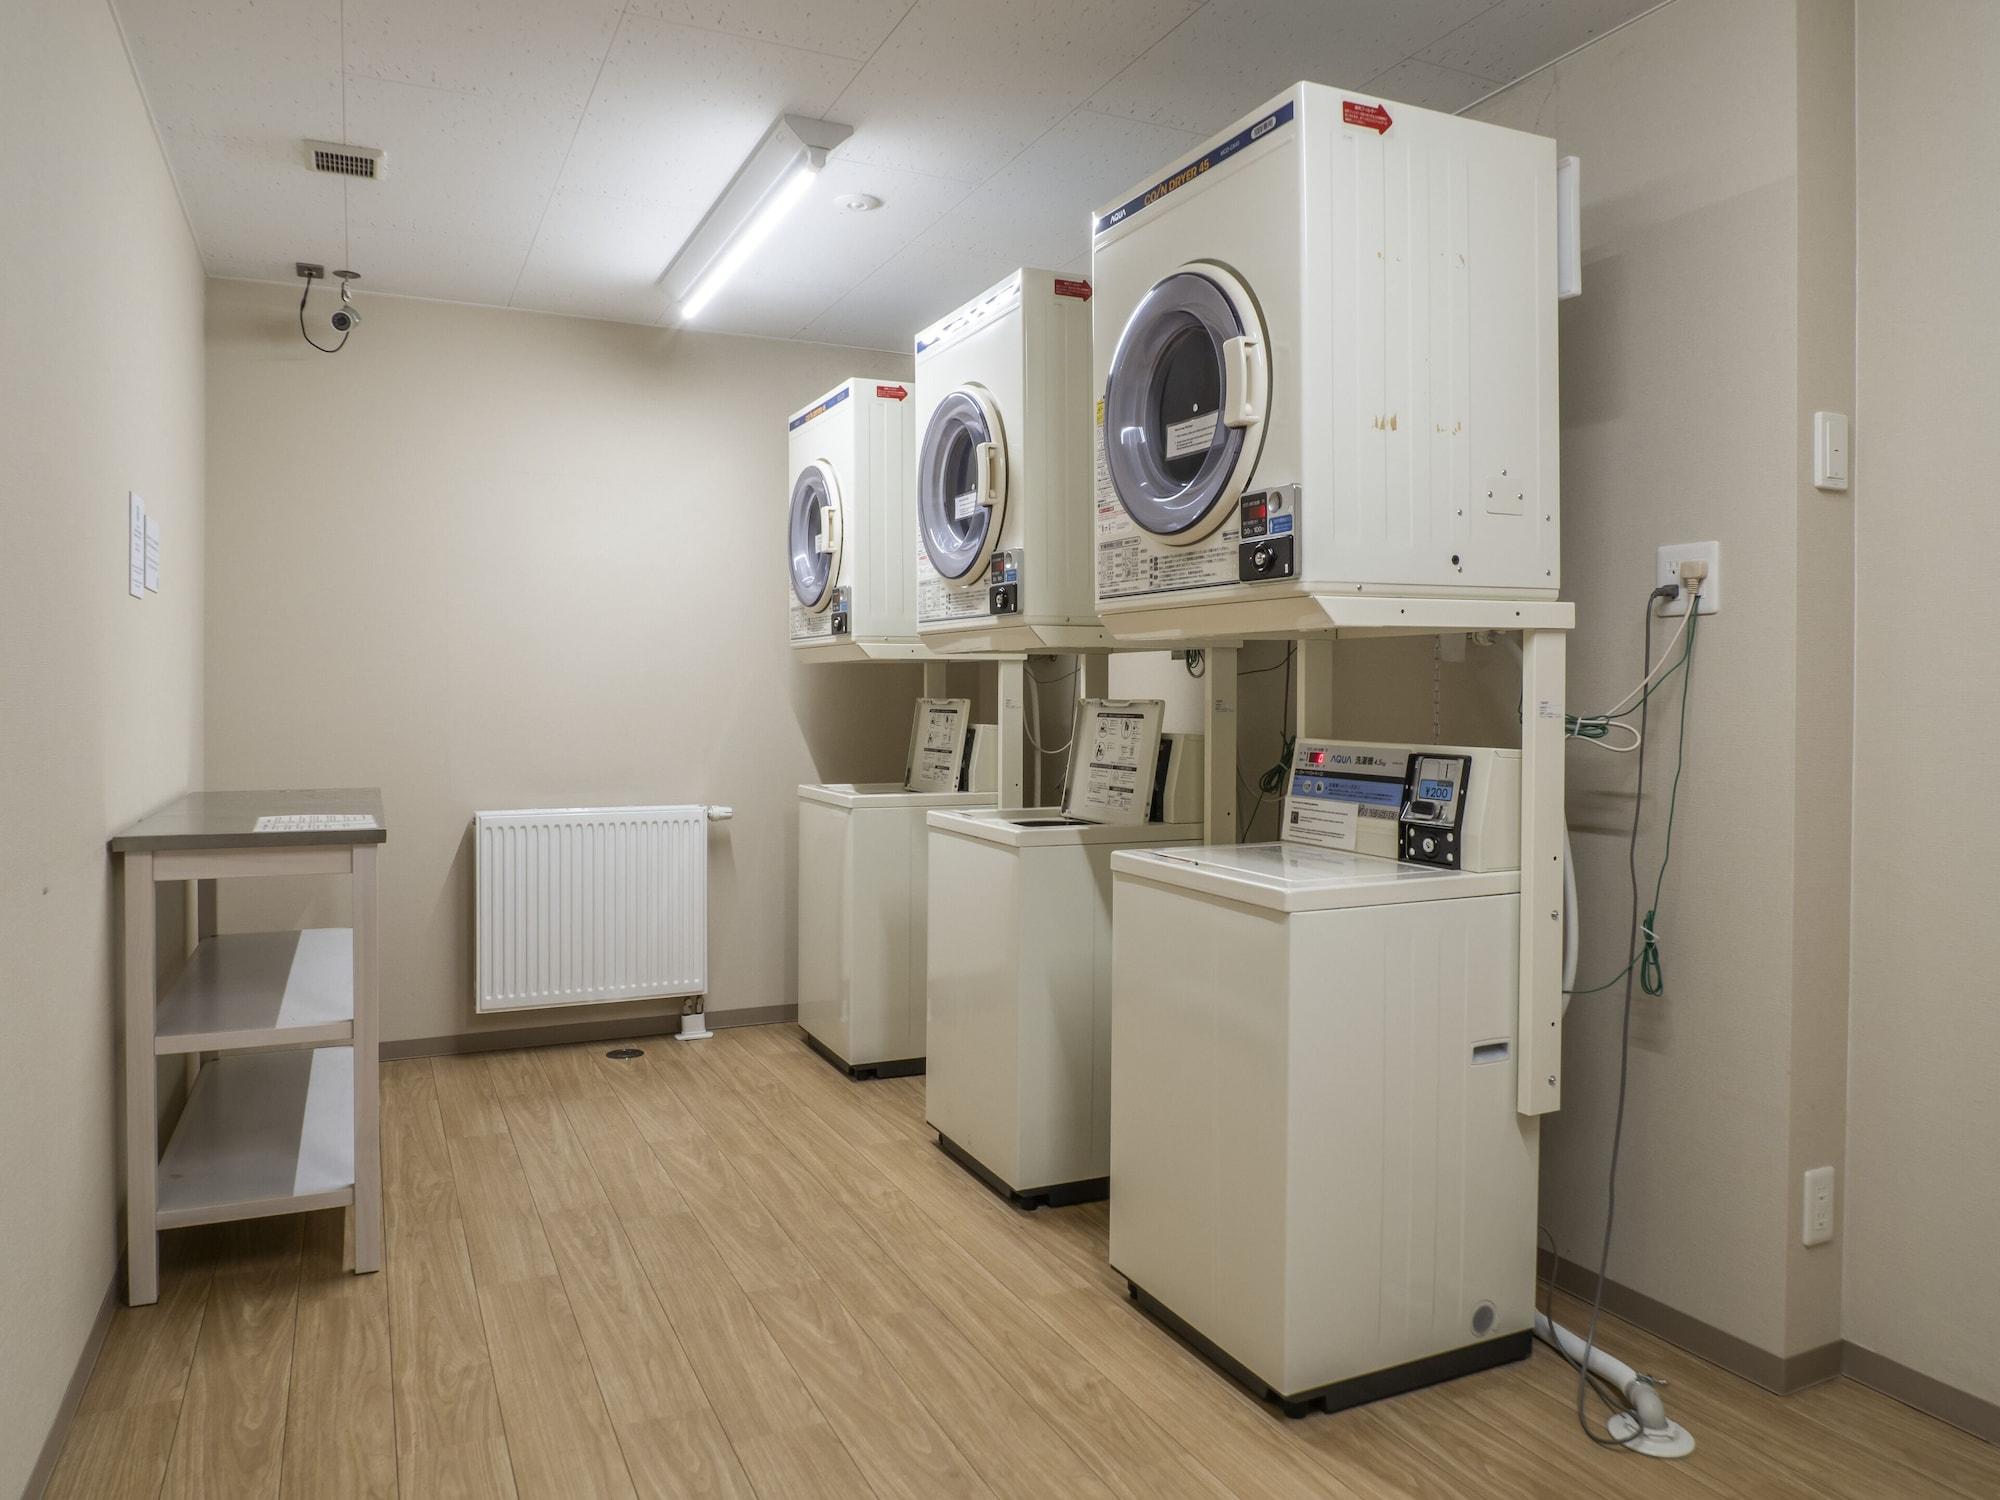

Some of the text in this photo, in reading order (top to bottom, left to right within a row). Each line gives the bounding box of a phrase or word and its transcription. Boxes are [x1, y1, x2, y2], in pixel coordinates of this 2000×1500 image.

[1109, 209, 1127, 224] AQUA
[1168, 166, 1197, 190] DRYER
[1199, 158, 1210, 173] 45
[1330, 755, 1352, 765] AQUA
